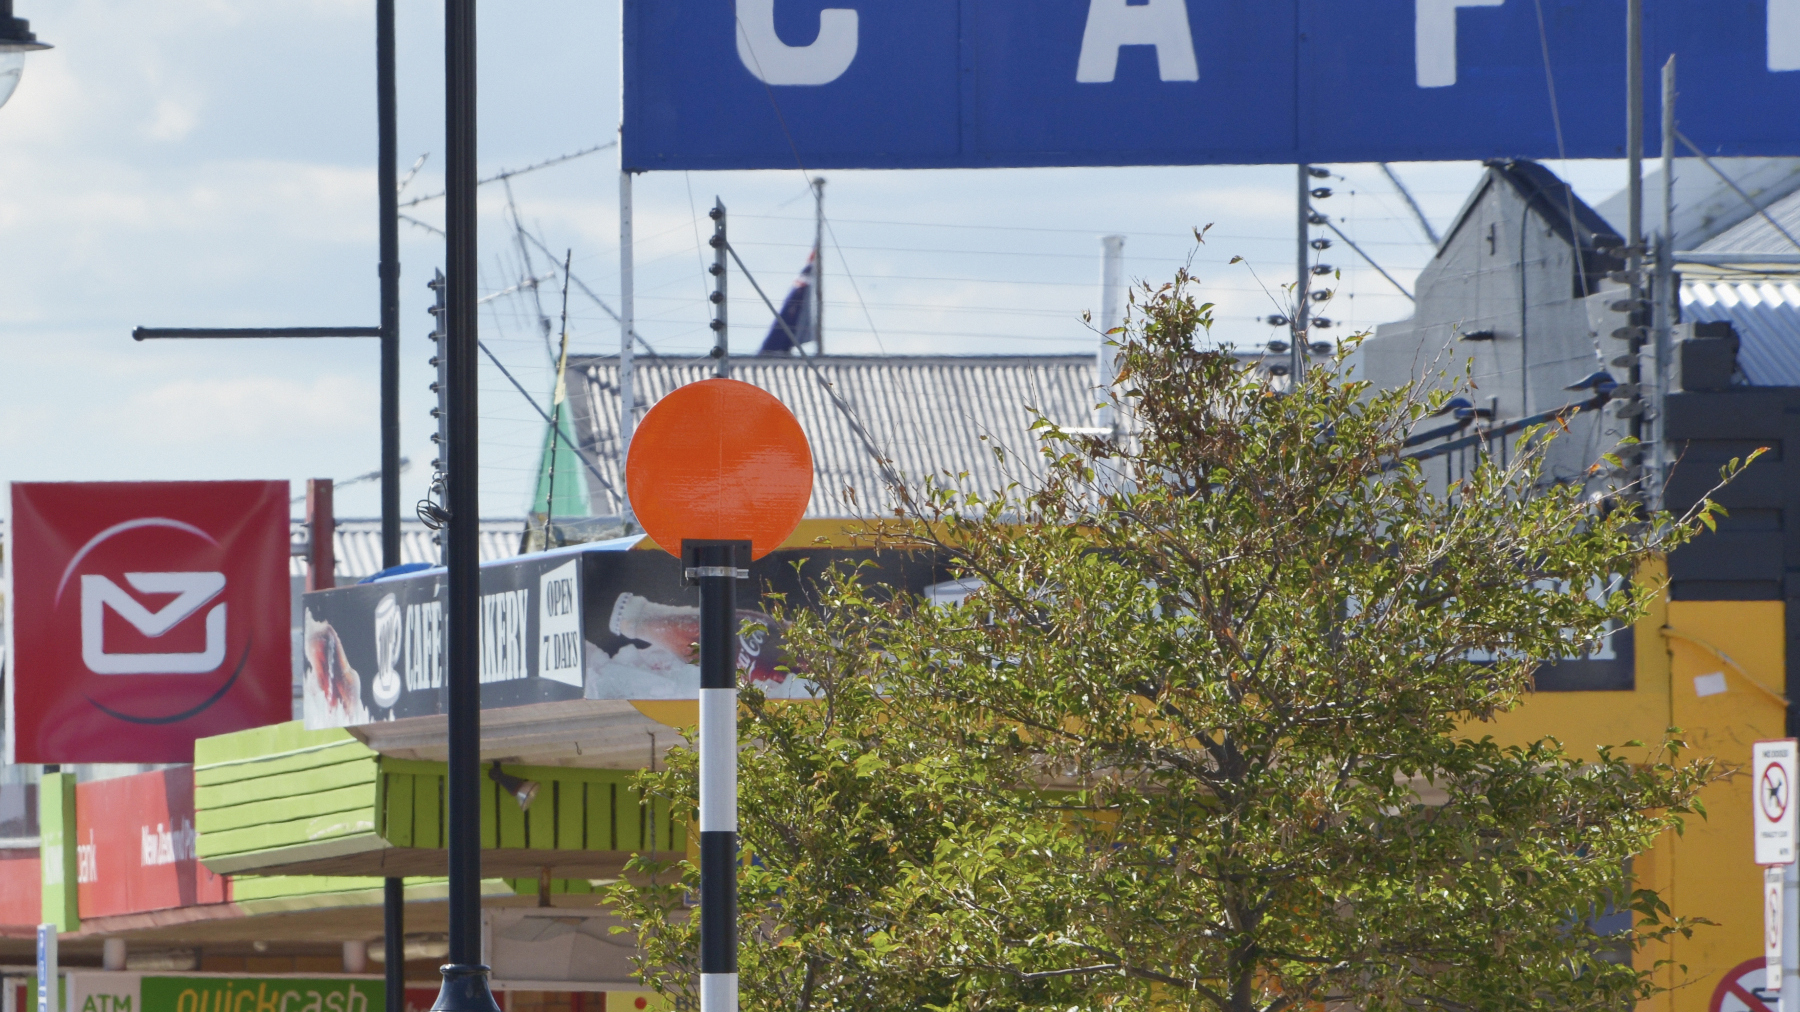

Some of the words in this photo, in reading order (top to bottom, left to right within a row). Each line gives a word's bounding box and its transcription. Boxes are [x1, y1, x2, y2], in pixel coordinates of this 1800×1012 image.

[547, 578, 573, 617] OPEN
[405, 581, 442, 693] CAFÉ
[543, 635, 550, 671] 7
[554, 631, 578, 669] DAYS
